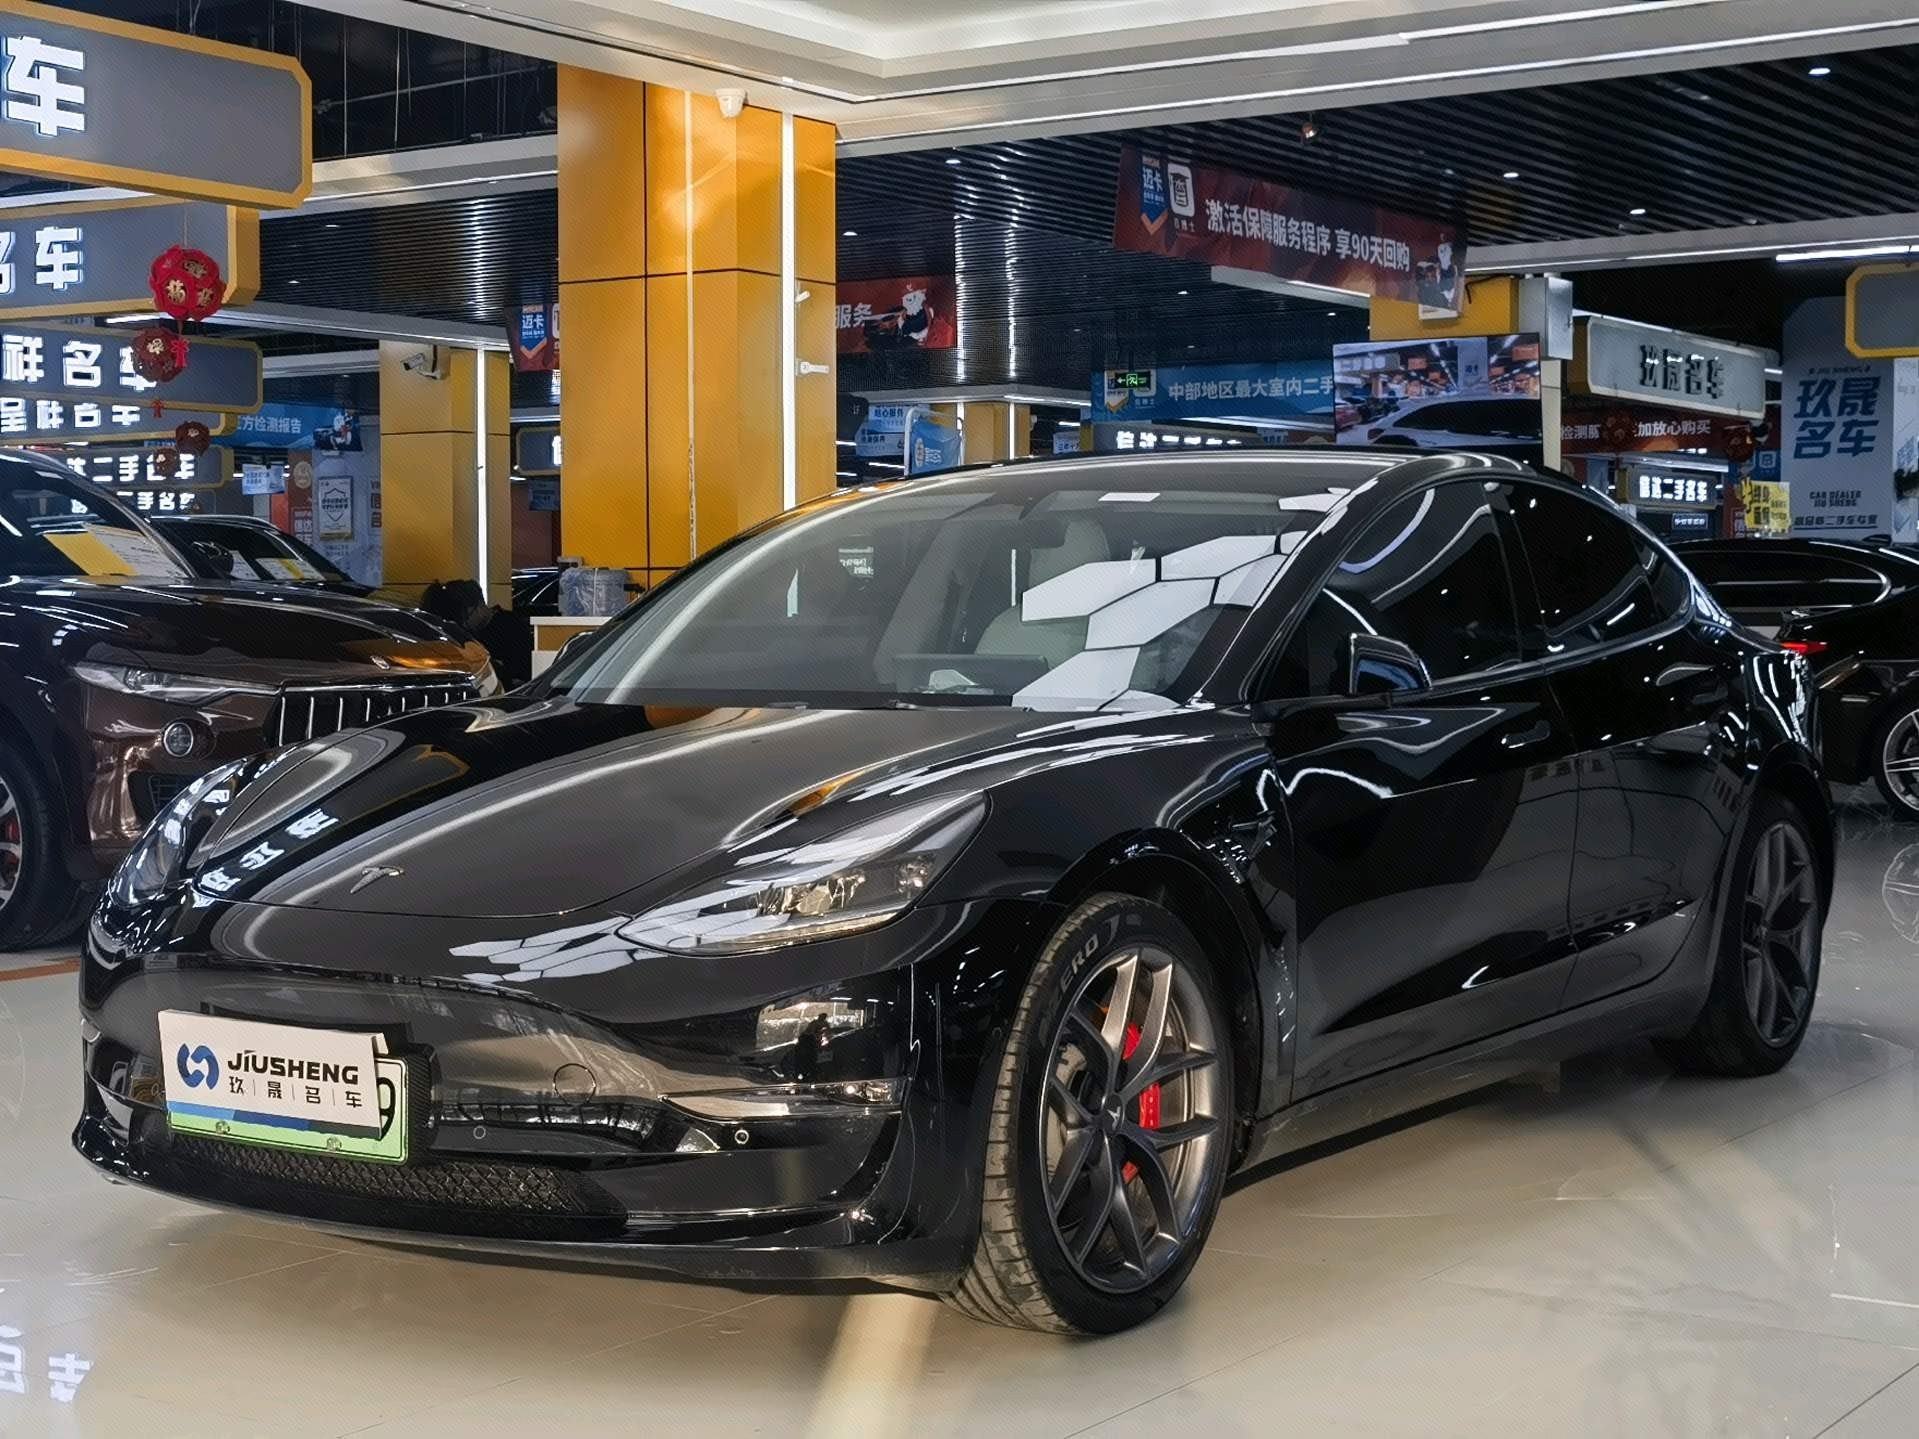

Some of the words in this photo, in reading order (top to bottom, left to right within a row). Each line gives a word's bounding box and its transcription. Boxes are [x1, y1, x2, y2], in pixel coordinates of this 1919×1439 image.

[1206, 199, 1331, 256] 激活保障服务程序
[1335, 228, 1410, 272] 享90天回购
[1168, 375, 1334, 401] 中部地区最大室内二手
[1794, 376, 1881, 419] 玖晟
[1635, 419, 1711, 438] 加放心购买
[1794, 419, 1880, 460] 名车
[227, 1050, 359, 1085] JIUSHENG
